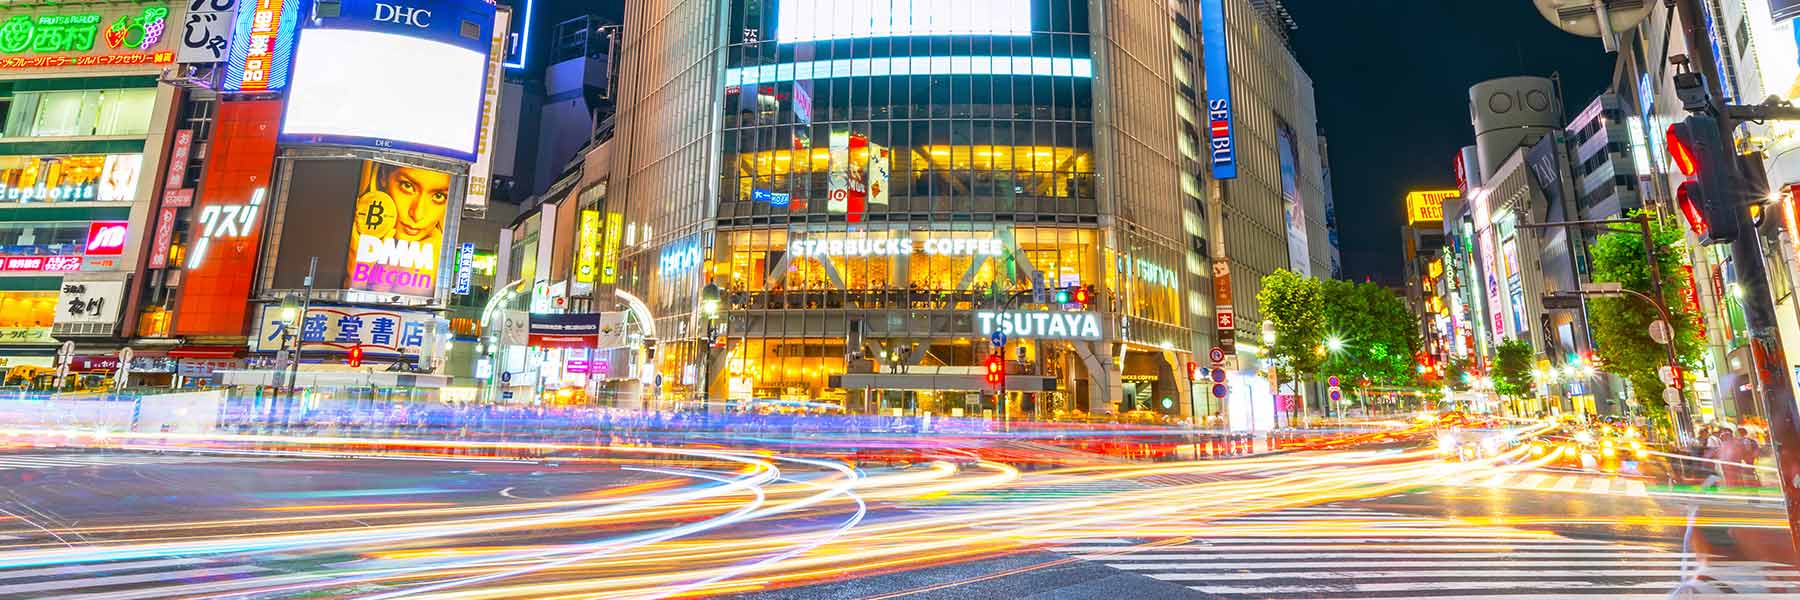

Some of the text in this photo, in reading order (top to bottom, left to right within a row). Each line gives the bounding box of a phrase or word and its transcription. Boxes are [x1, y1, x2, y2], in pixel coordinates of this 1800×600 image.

[373, 3, 432, 28] DHC
[33, 26, 97, 51] 西村
[375, 139, 393, 148] DHC
[1209, 99, 1232, 165] SEIBU
[187, 188, 265, 269] クスリ
[355, 234, 434, 270] DMM
[791, 238, 1002, 256] STARBUCKS COFFEE
[352, 262, 432, 289] Bitcoin
[267, 314, 424, 347] 大盛堂書店
[978, 312, 1100, 337] TSUTAYA
